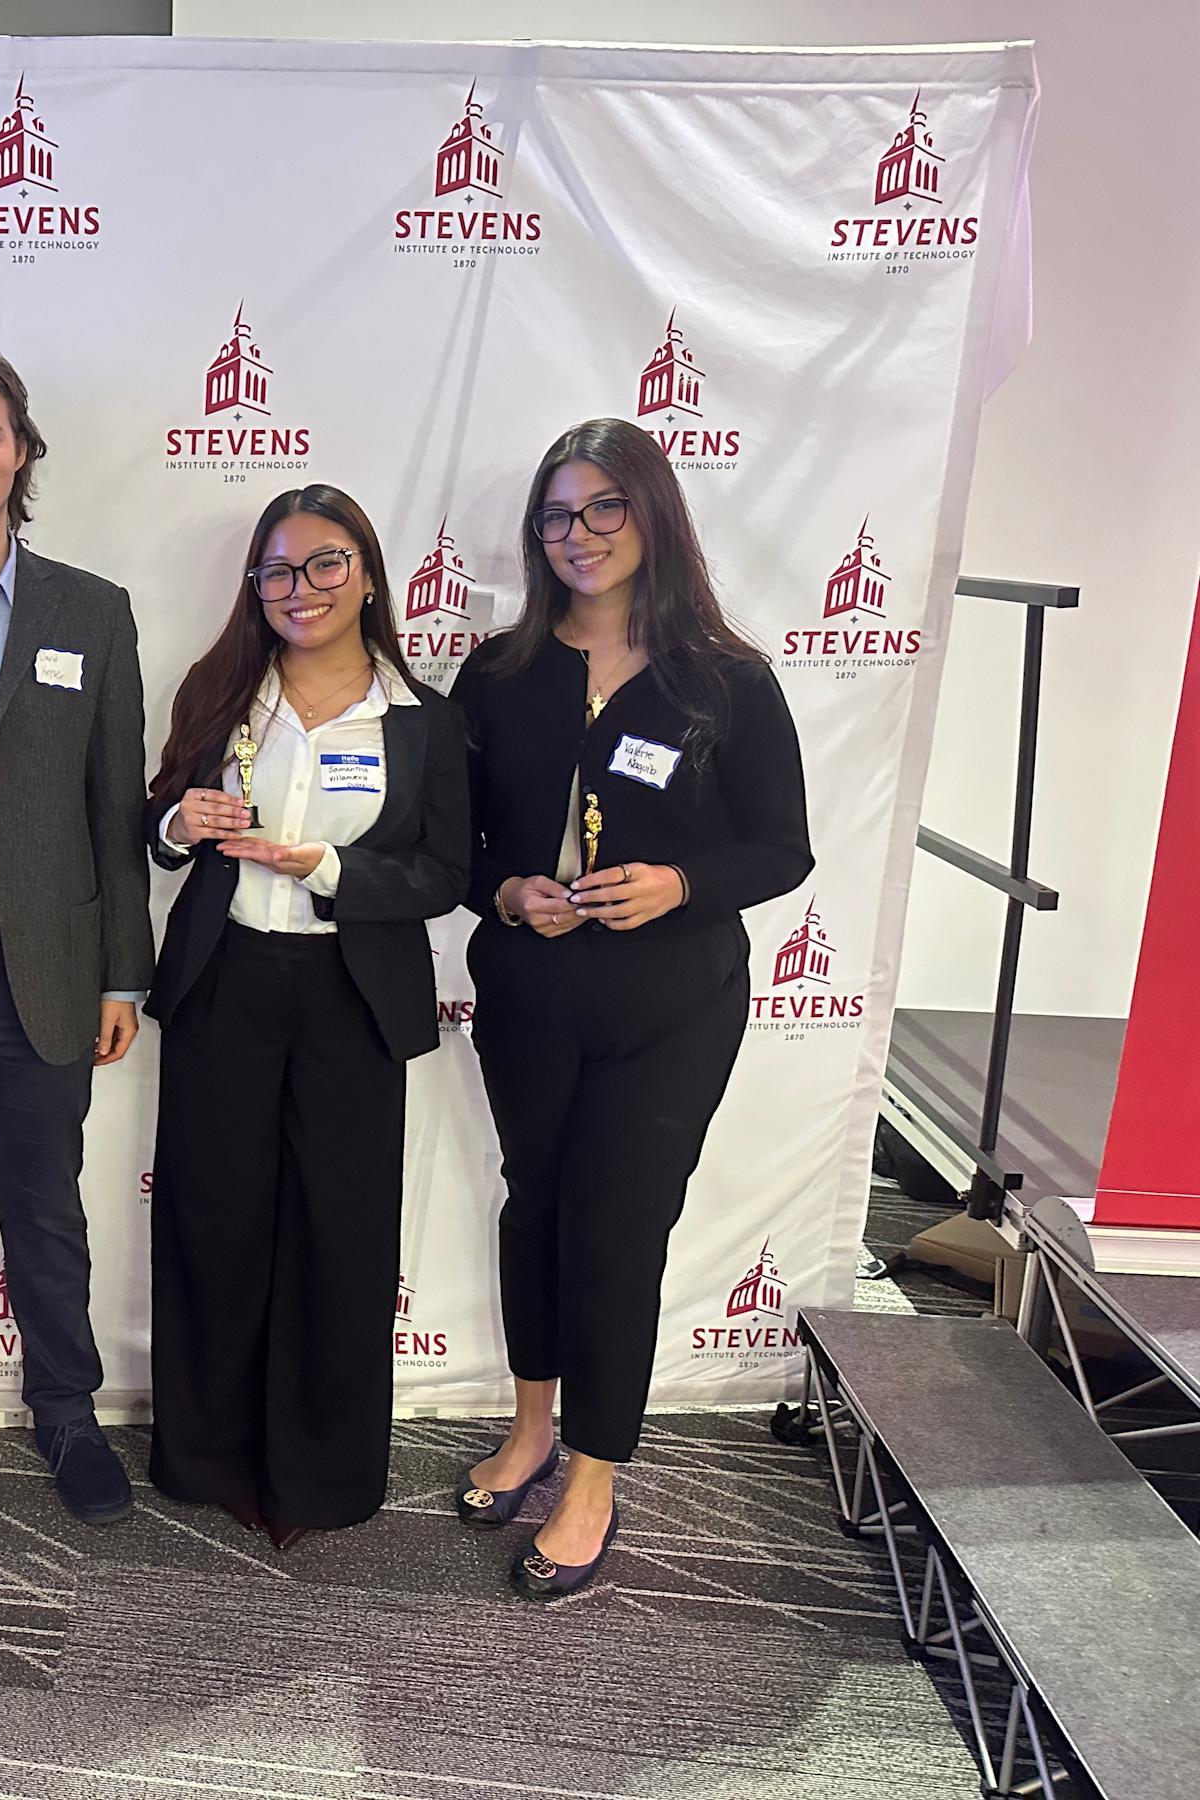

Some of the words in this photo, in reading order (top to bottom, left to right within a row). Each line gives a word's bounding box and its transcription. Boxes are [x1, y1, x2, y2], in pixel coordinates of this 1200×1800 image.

[395, 210, 541, 241] STEVENS
[830, 217, 978, 247] STEVENS
[9, 240, 24, 249] OF
[28, 241, 100, 250] TECHNOLOGY
[394, 244, 447, 254] INSTITUTE
[451, 245, 466, 254] OF
[470, 246, 540, 255] TECHNOLOGY
[12, 255, 35, 264] 1870
[827, 252, 880, 262] INSTITUTE
[884, 252, 900, 260] OF
[903, 250, 976, 260] TECHNOLOGY
[453, 259, 476, 268] 1870
[885, 265, 909, 274] 1870
[166, 429, 310, 456] STEVENS
[646, 430, 740, 457] VENS
[165, 461, 217, 469] INSTITUTE
[221, 461, 235, 469] OF
[239, 461, 309, 470] TECHNOLOGY
[223, 475, 246, 483] 1870
[783, 630, 921, 655] STEVENS
[420, 662, 434, 670] OF
[781, 659, 830, 667] INSTITUTE
[834, 659, 848, 667] OF
[852, 658, 917, 667] TECHNOLOGY
[421, 674, 443, 682] 1870
[835, 671, 857, 679] 1870
[751, 995, 864, 1019] TEVENS
[748, 1023, 780, 1031] TITUTE
[800, 1022, 862, 1030] TECHNOLOGY
[784, 1033, 805, 1041] 1870
[692, 1327, 798, 1349] STEVEN
[691, 1351, 735, 1359] INSTITUTE
